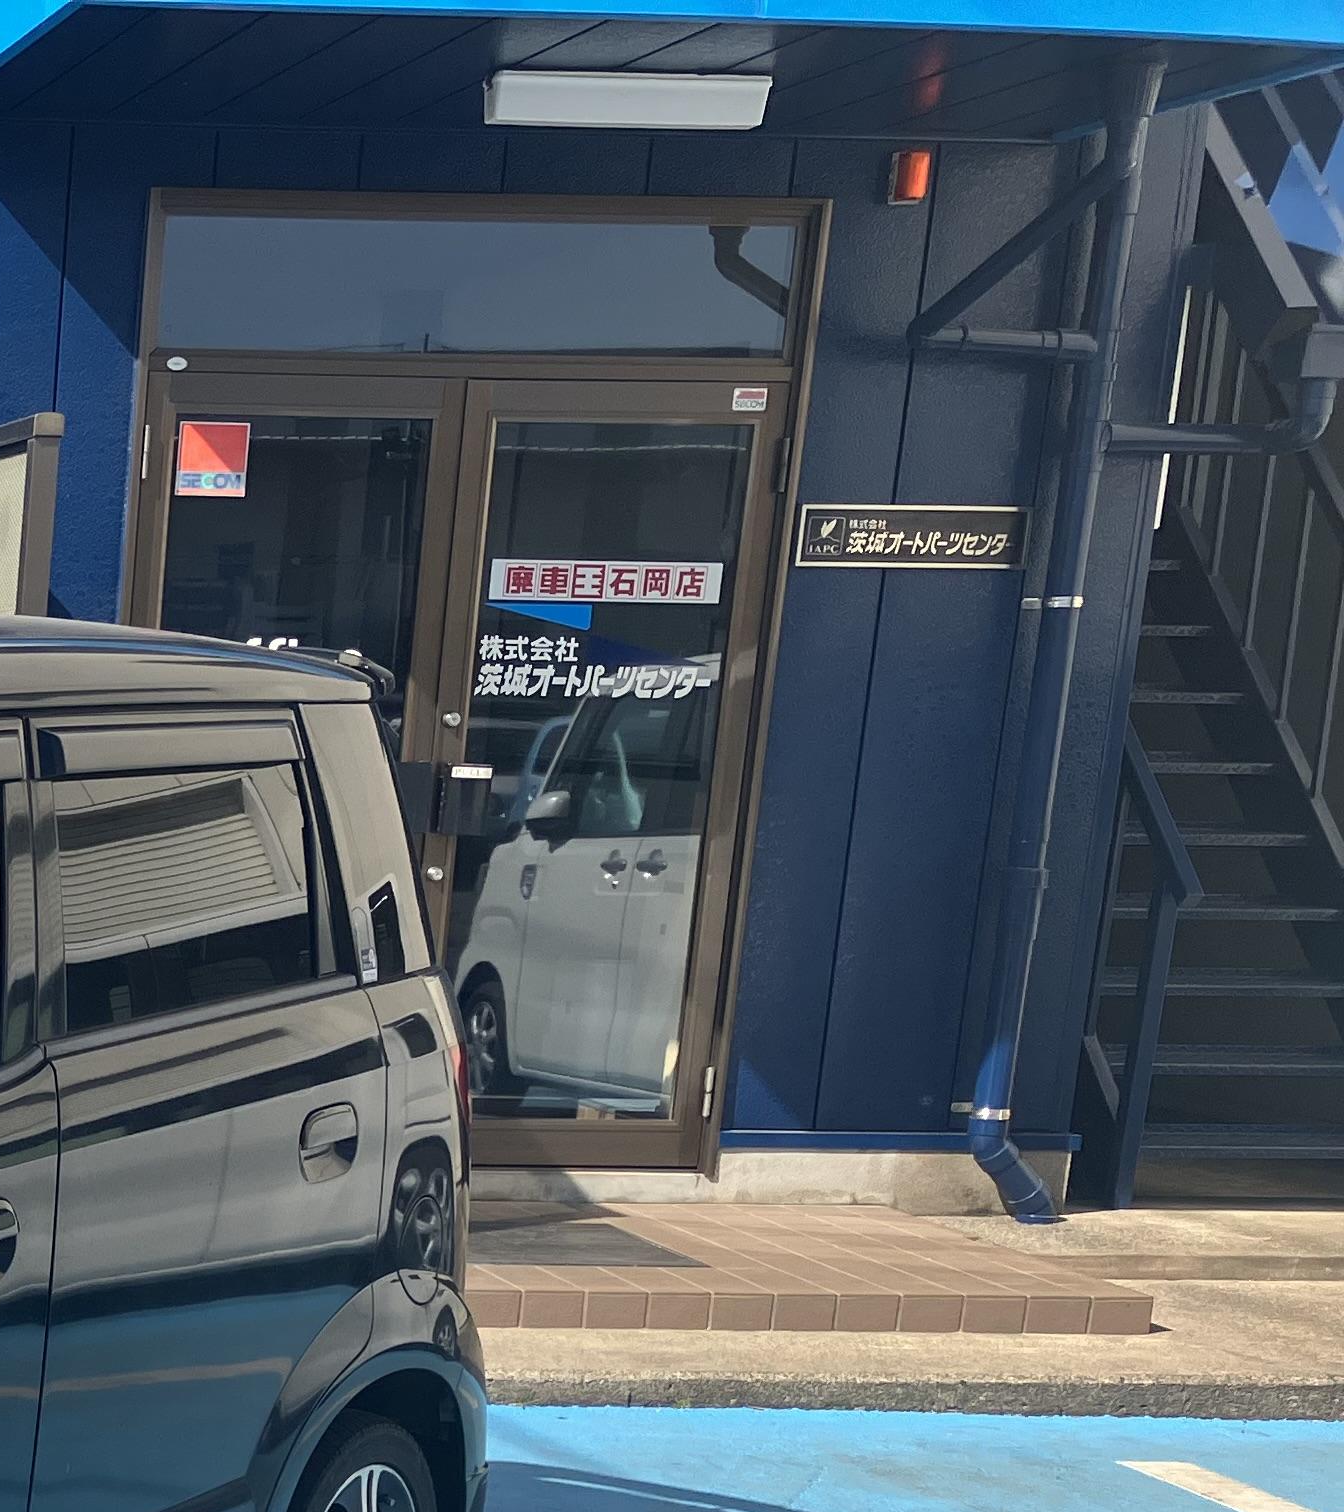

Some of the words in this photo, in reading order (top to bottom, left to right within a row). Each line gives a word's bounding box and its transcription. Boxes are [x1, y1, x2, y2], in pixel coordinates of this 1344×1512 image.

[180, 473, 241, 489] SECOM
[849, 519, 888, 530] 株式会社
[808, 544, 839, 554] IAPC
[479, 634, 579, 662] 株式会社
[474, 663, 712, 699] 茨城オートパーツセンター
